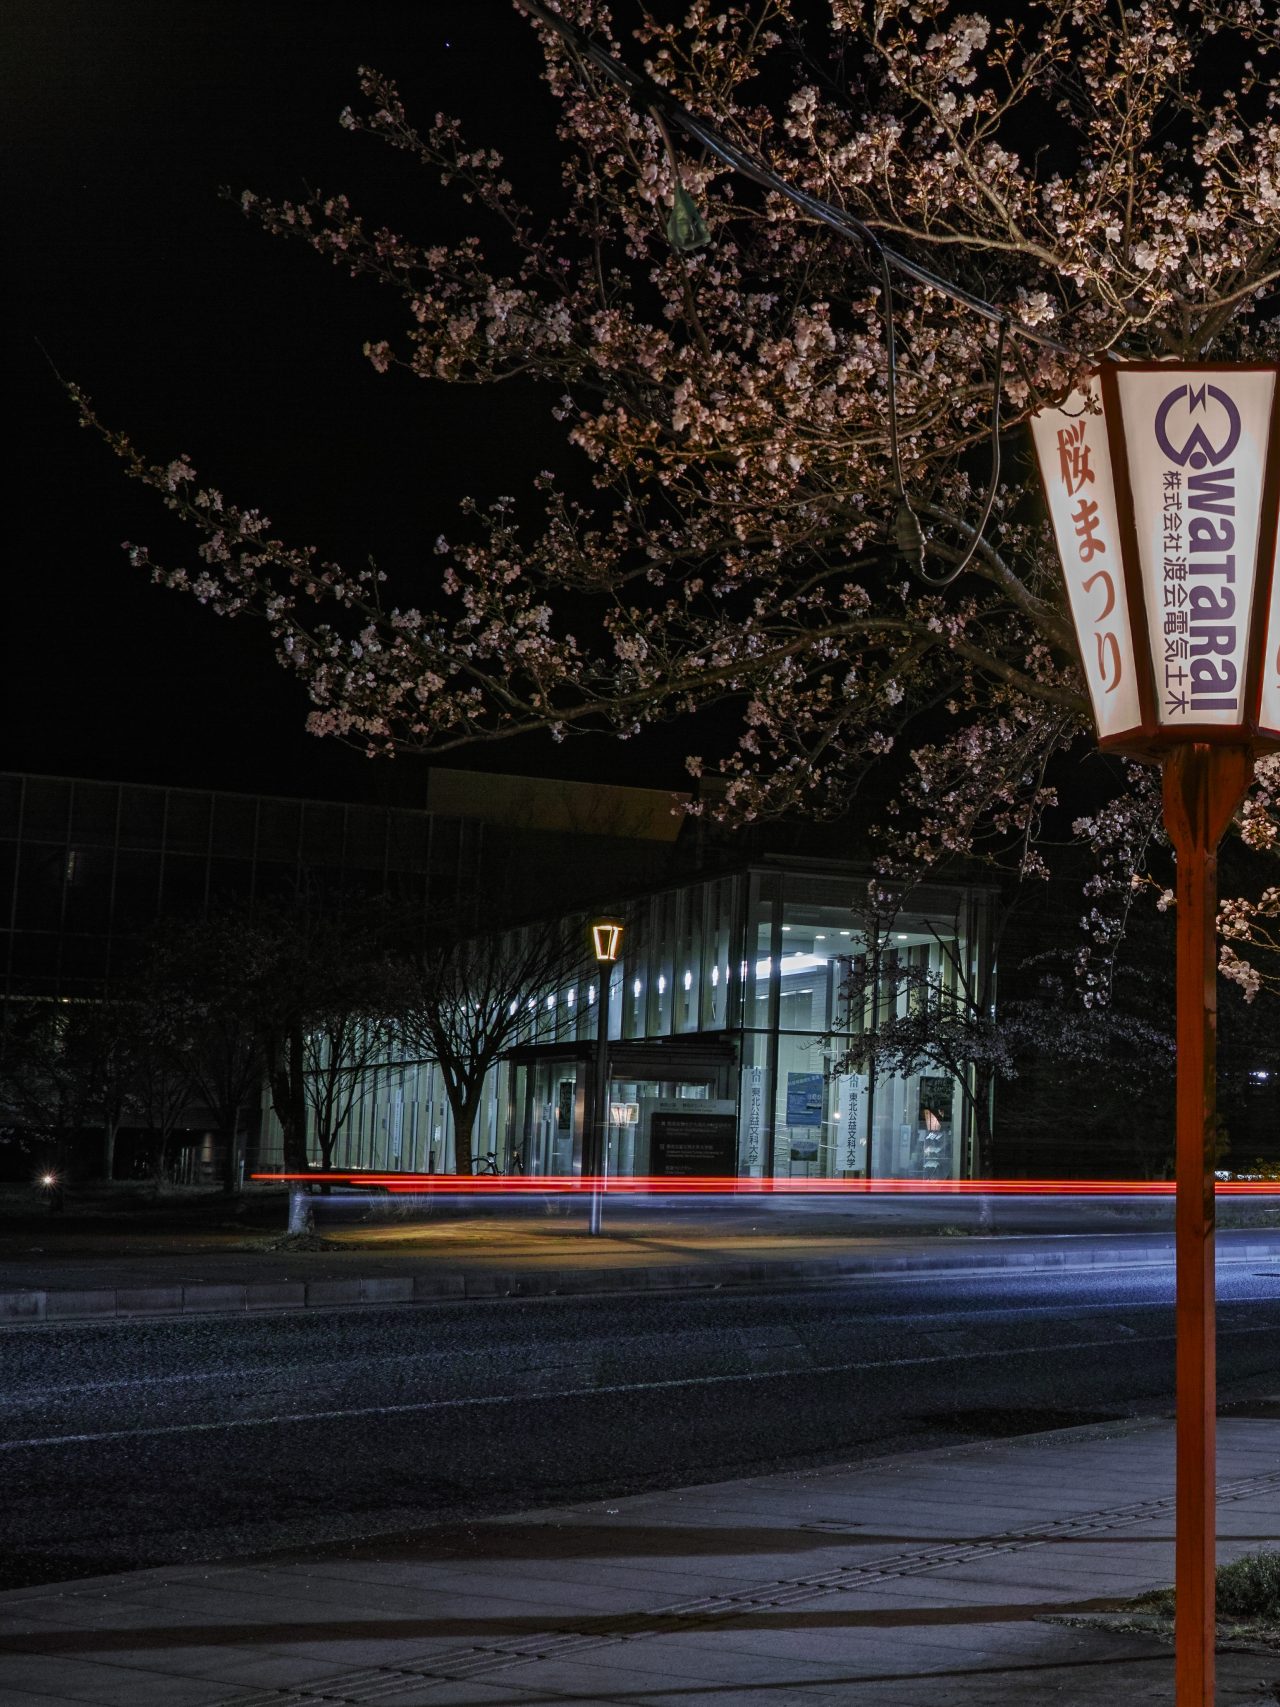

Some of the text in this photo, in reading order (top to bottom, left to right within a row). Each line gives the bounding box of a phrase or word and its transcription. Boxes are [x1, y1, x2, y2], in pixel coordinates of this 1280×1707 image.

[1056, 419, 1123, 693] 桜まつり
[1161, 470, 1190, 716] 株式会社渡会電気土木
[748, 1087, 761, 1164] 東北公益文科大学
[846, 1092, 858, 1168] 東北公益文科大学
